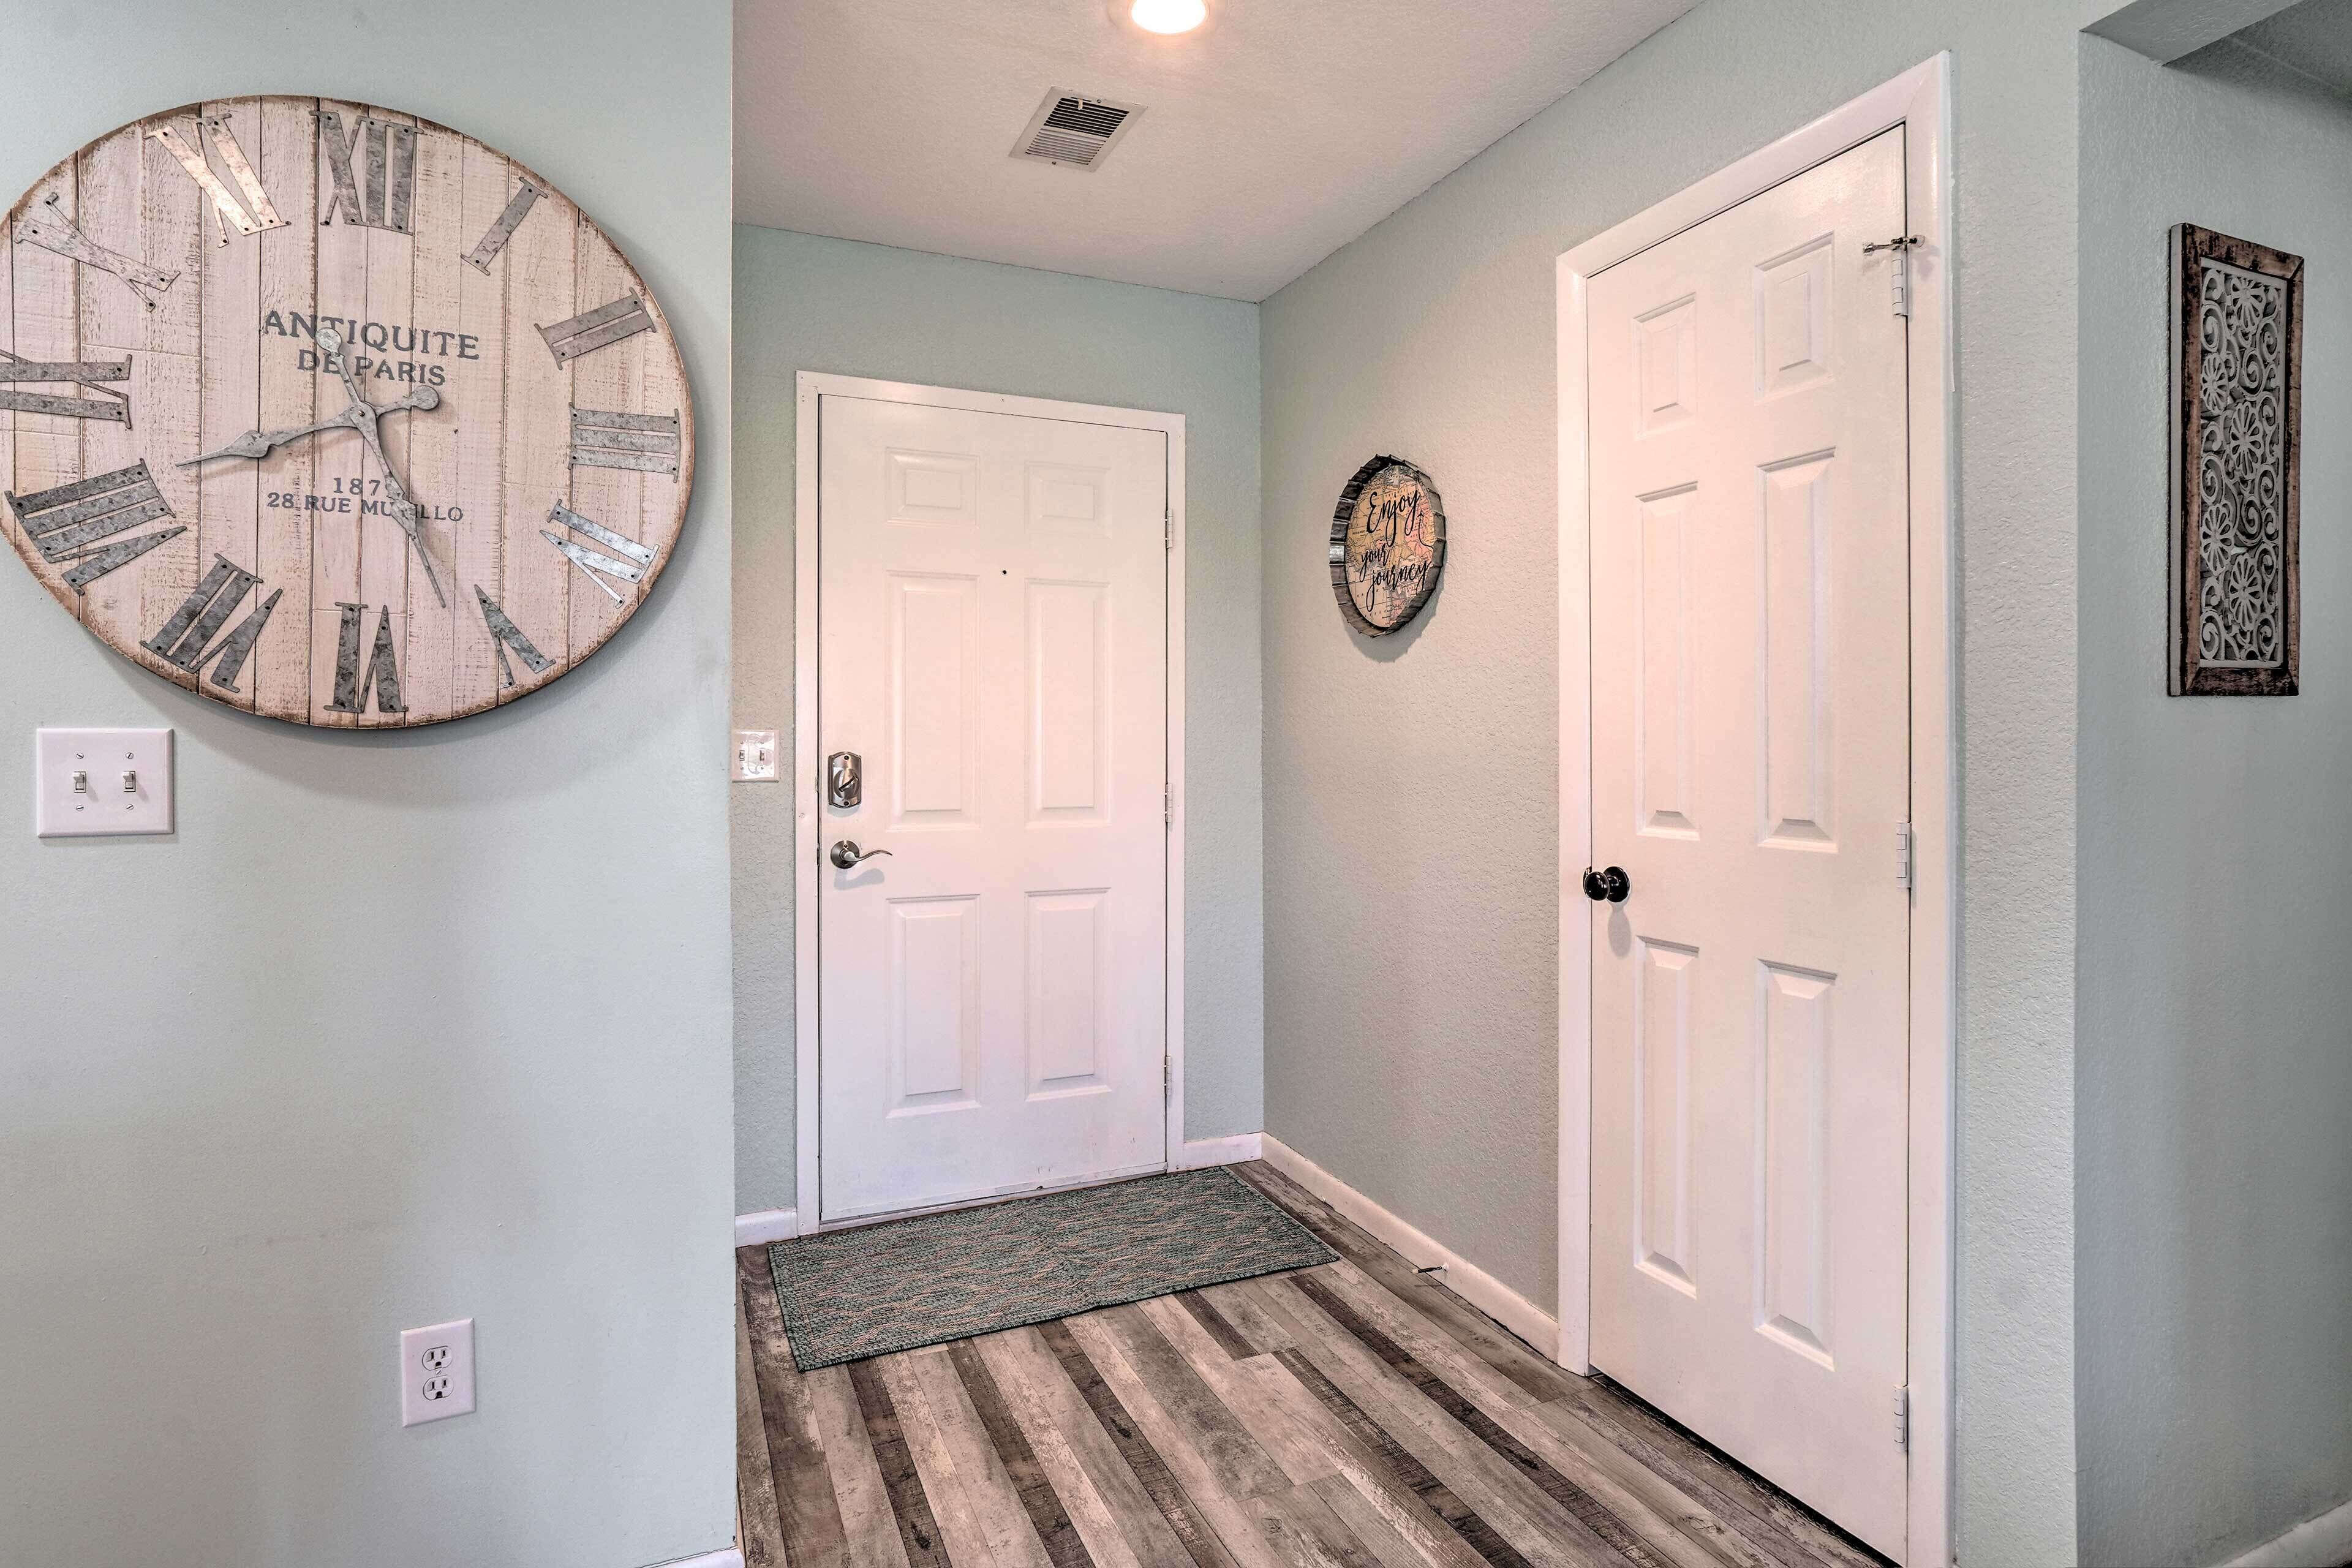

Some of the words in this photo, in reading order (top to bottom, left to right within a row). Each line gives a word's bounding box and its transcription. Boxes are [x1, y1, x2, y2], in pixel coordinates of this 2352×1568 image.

[143, 113, 292, 249] XI
[309, 109, 424, 236] XII
[13, 191, 181, 313] X
[264, 309, 480, 360] ANTIQUITE
[298, 349, 341, 374] DE
[354, 356, 446, 386] PARIS
[533, 287, 657, 371] II
[568, 402, 681, 484] III
[5, 457, 187, 596] VIII
[267, 492, 295, 509] 28
[304, 494, 352, 513] RUE
[361, 499, 464, 521] MUILLO
[333, 477, 382, 496] 187
[1366, 489, 1420, 547] Enjoy
[539, 498, 660, 609] IV
[1359, 543, 1391, 582] your
[1366, 560, 1432, 612] journey
[139, 552, 284, 693] VII
[323, 601, 409, 714] VI
[473, 584, 556, 688] V
